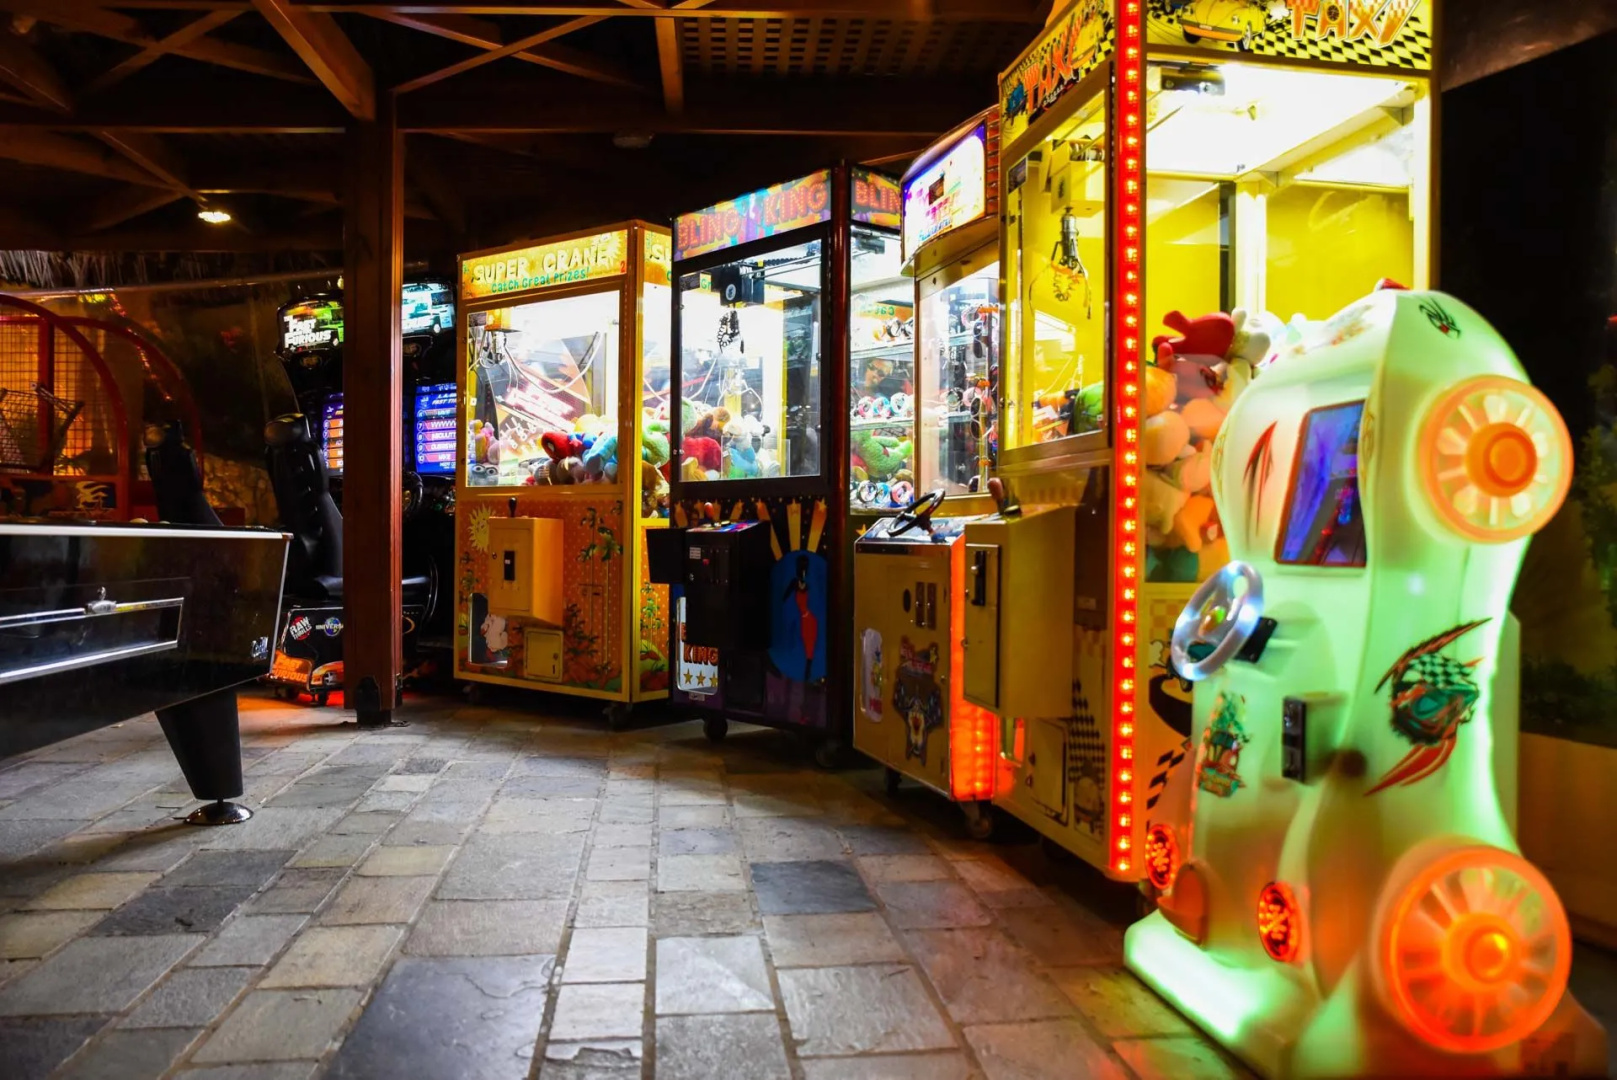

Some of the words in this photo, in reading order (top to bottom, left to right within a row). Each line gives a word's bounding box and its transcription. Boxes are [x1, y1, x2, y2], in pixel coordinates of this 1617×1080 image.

[676, 210, 742, 251] BLING
[762, 181, 829, 227] KING
[471, 255, 530, 285] SUPER
[541, 241, 609, 274] CRANE
[522, 271, 552, 289] Great
[553, 266, 590, 283] Prizes!
[289, 616, 310, 635] RAW
[684, 643, 718, 667] KING
